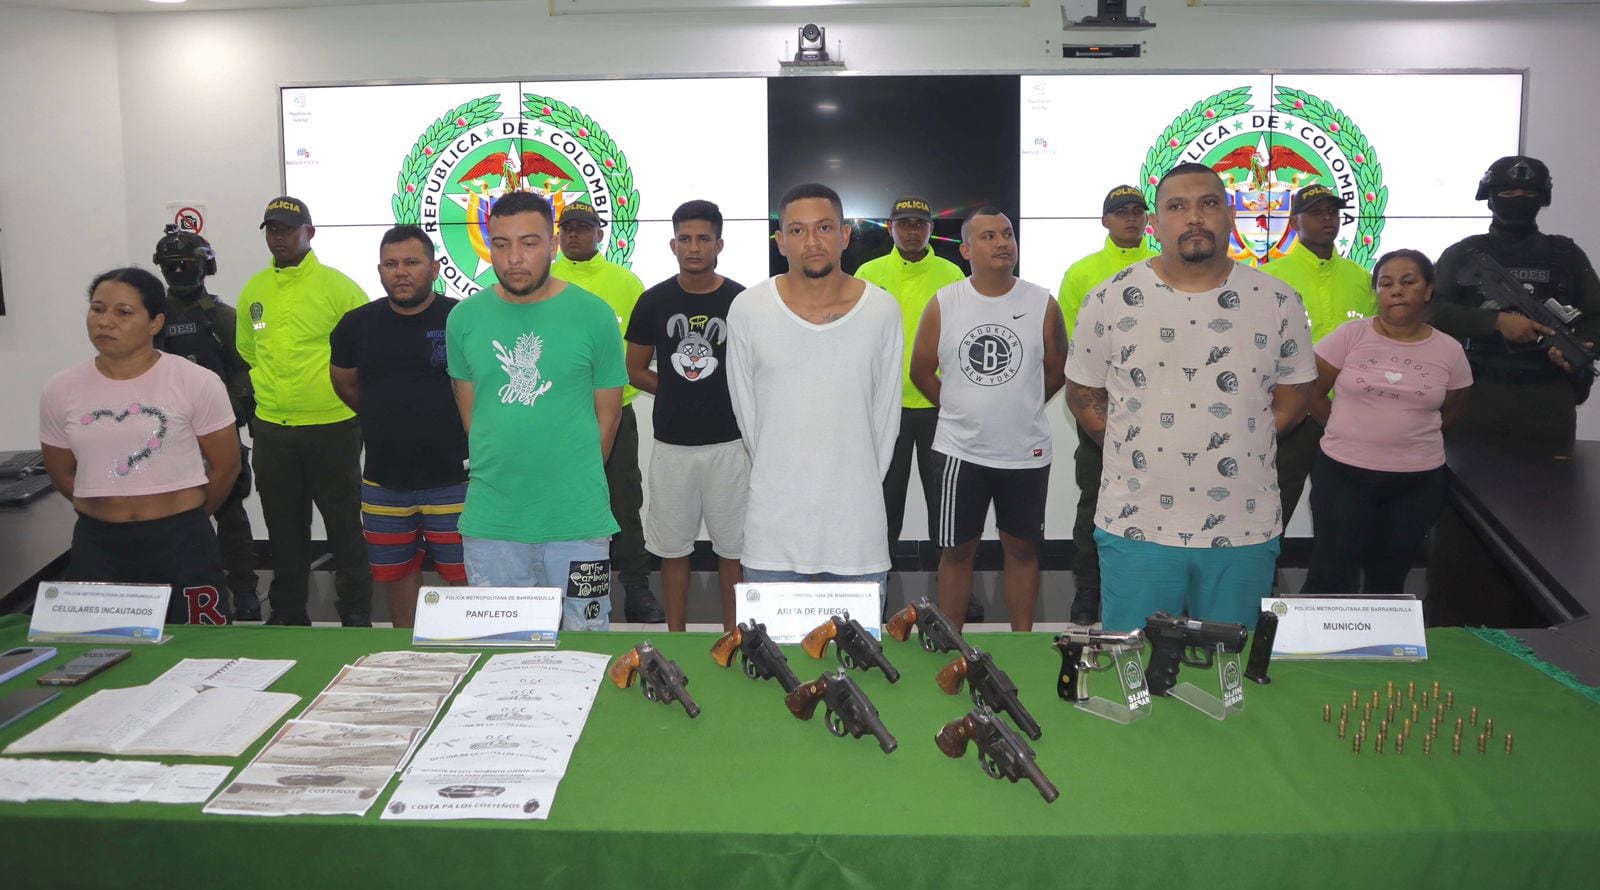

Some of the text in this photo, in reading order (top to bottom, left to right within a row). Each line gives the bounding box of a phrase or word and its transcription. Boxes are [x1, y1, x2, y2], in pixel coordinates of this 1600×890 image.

[425, 122, 608, 232] REPÚBLICA DE COLOMBIA
[1252, 115, 1279, 128] DE
[1301, 127, 1355, 226] COLOMBIA
[896, 200, 930, 212] POLICIA
[438, 256, 480, 296] POLIC
[964, 327, 1018, 347] BROOKLYN
[983, 340, 998, 371] B
[964, 365, 1015, 384] NEW YORK
[1390, 356, 1430, 378] COOL
[580, 562, 603, 575] The
[52, 605, 153, 616] CELULARES INCAUTADOS
[183, 585, 227, 625] R
[465, 610, 519, 618] PANFLETOS
[1323, 621, 1371, 631] MUNICIÓN
[1128, 689, 1149, 703] SIJIN
[1224, 686, 1243, 700] SIJIN
